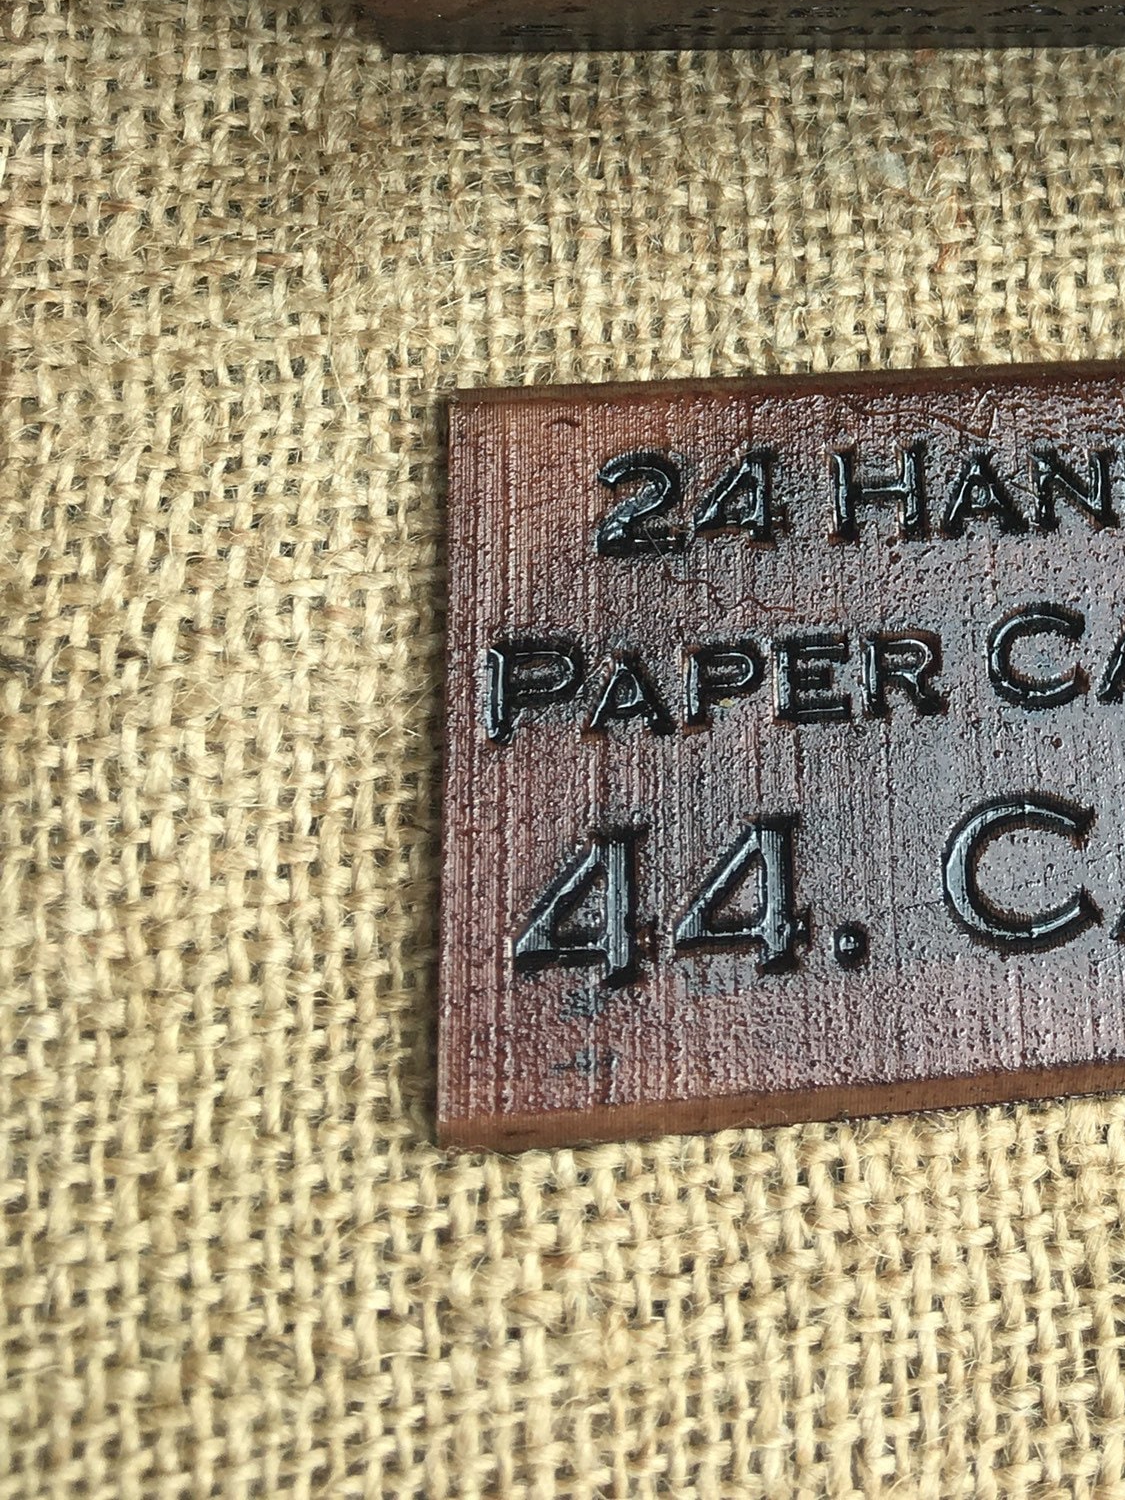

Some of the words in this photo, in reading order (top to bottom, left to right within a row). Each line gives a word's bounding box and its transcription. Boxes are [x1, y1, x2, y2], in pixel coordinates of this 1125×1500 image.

[597, 448, 776, 558] 24
[486, 630, 945, 744] PAPER
[510, 812, 868, 990] 44.
